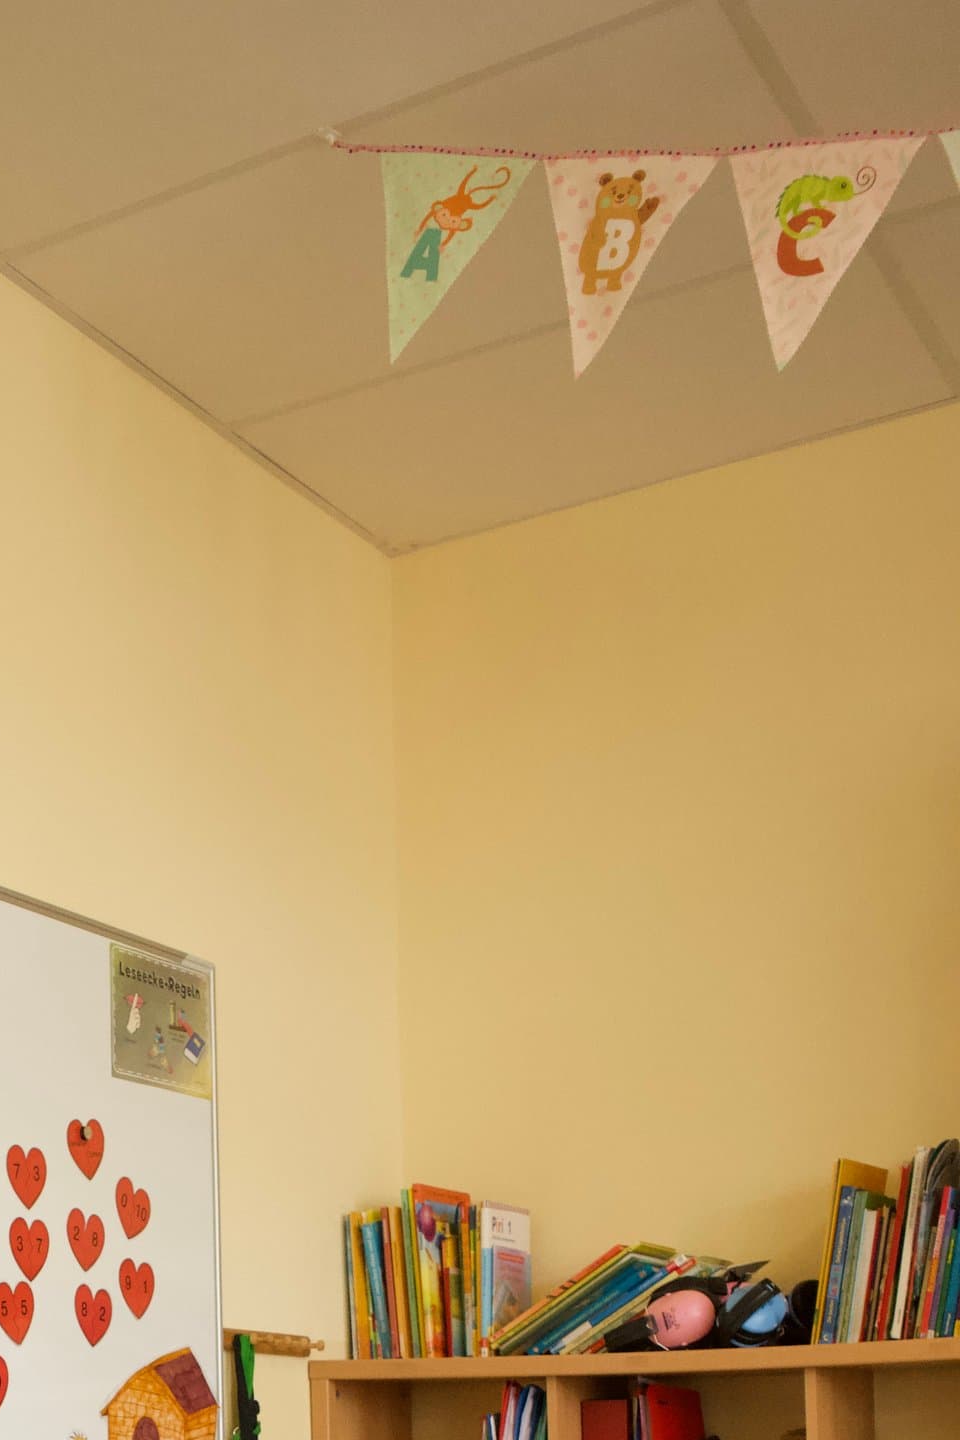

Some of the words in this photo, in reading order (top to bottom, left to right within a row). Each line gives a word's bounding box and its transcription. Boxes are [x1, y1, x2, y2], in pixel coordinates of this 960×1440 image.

[596, 219, 636, 271] B
[776, 207, 837, 278] C
[400, 228, 442, 283] A
[12, 1163, 21, 1179] 7
[33, 1166, 41, 1182] 3
[135, 1204, 148, 1222] 10
[16, 1236, 24, 1252] 3
[36, 1238, 44, 1253] 7
[73, 1225, 81, 1241] 2
[91, 1232, 99, 1247] 8
[124, 1275, 132, 1290] 9
[142, 1280, 149, 1294] 1
[0, 1300, 9, 1317] 5
[20, 1300, 29, 1316] 5
[81, 1301, 89, 1317] 8
[99, 1306, 107, 1322] 2
